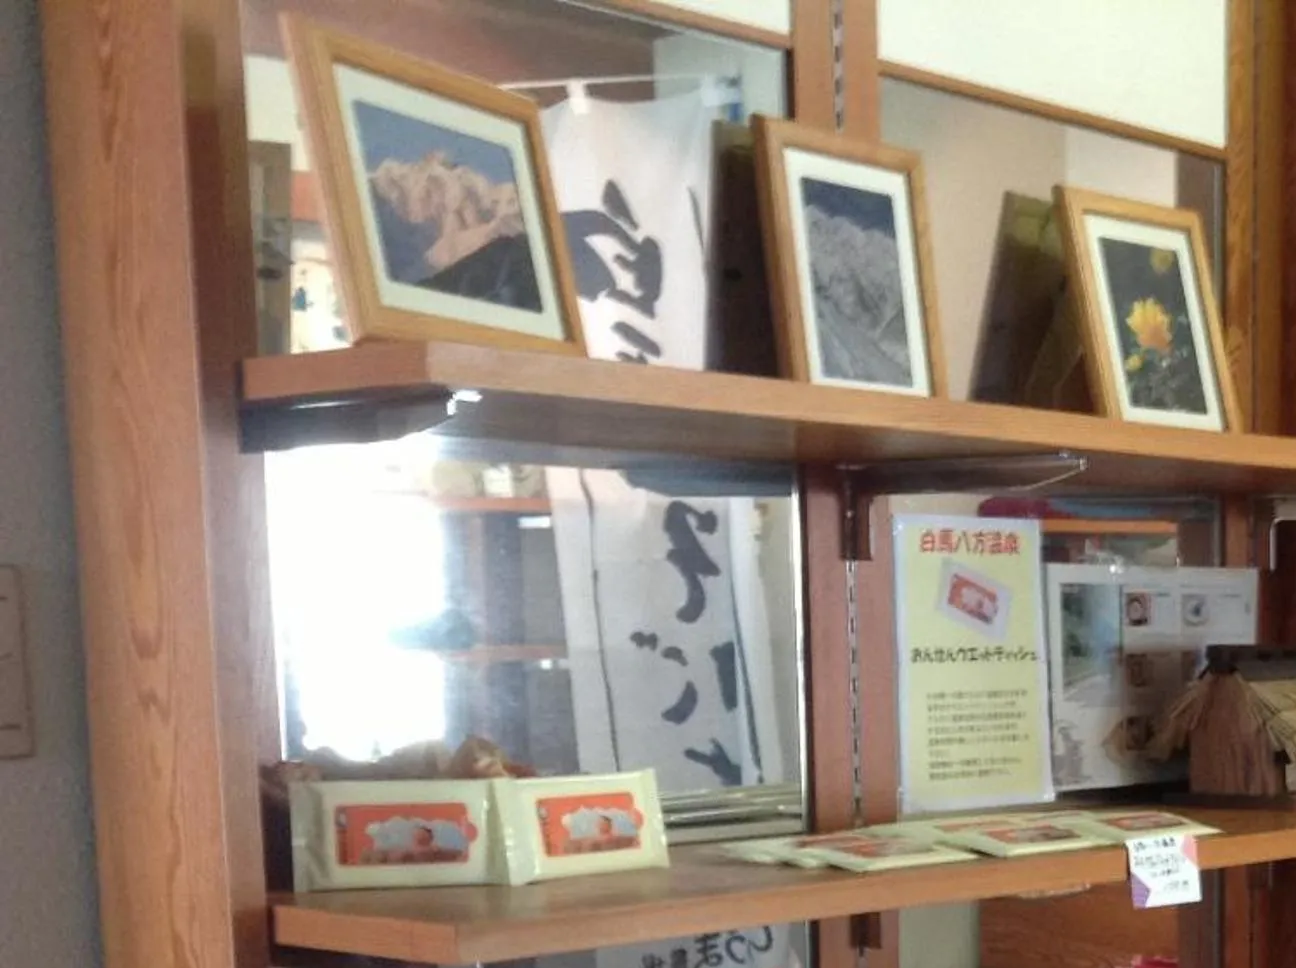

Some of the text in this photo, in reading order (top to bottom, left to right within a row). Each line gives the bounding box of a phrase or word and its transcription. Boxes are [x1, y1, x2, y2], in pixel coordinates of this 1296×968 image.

[919, 528, 1021, 556] 白馬八方温泉
